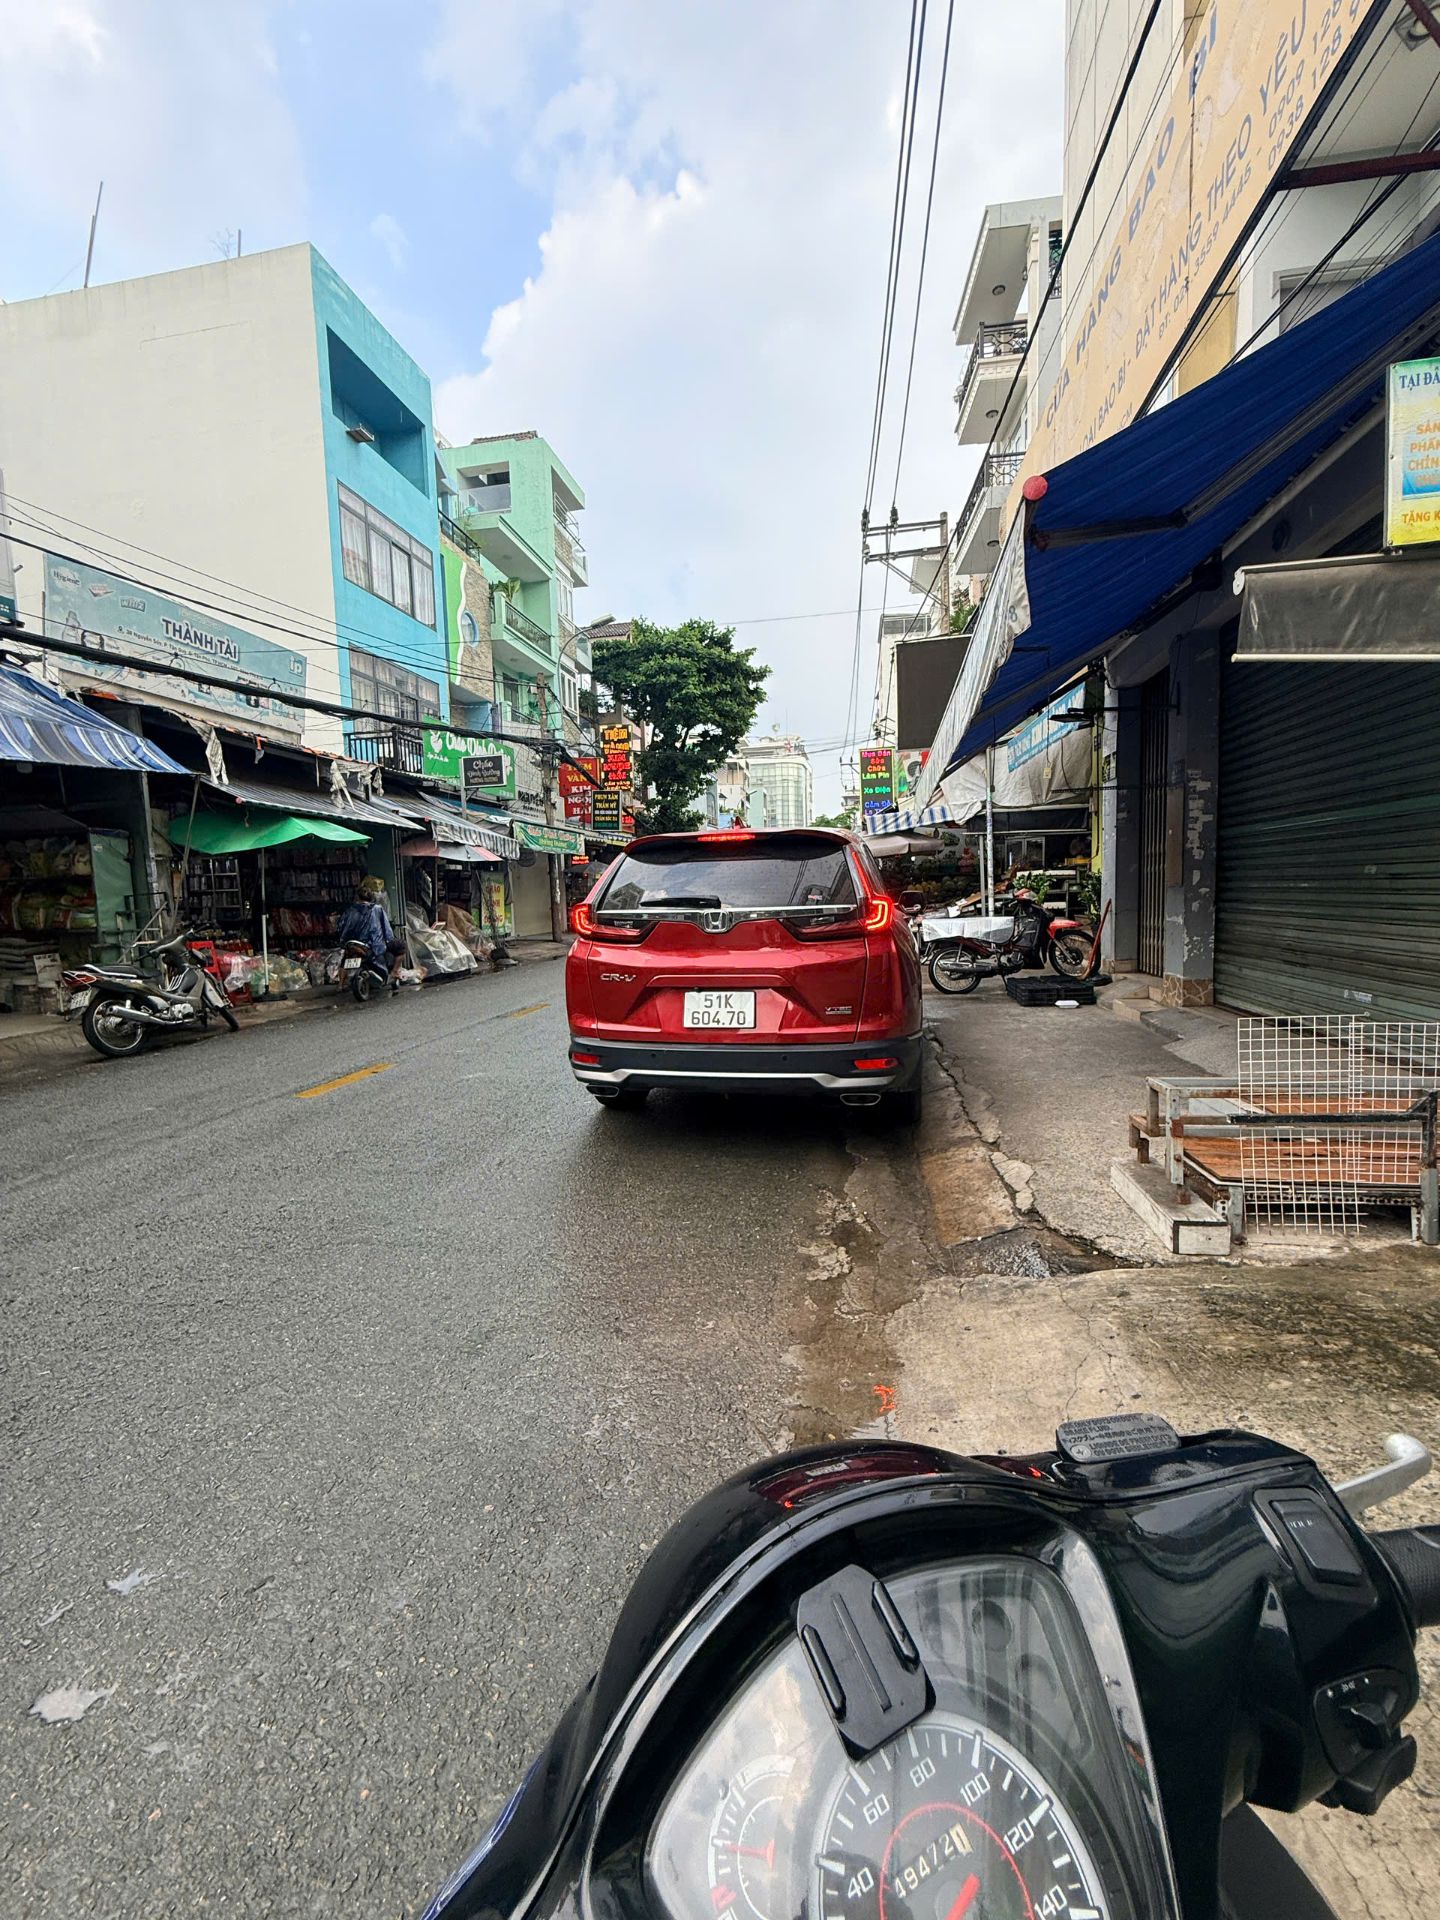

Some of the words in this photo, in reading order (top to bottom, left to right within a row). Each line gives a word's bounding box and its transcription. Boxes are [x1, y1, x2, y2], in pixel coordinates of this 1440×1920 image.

[1268, 58, 1305, 138] 0909
[1268, 94, 1304, 171] 0938
[1311, 25, 1342, 90] 128
[1076, 245, 1122, 366] HÀNG
[1128, 116, 1175, 246] BAO
[1098, 381, 1116, 431] BAO
[1158, 211, 1203, 313] HÀNG
[1206, 113, 1252, 222] THEO
[1399, 372, 1420, 391] TẠI
[1402, 509, 1431, 527] TẶNG
[161, 617, 214, 651] THÀNH
[217, 637, 238, 660] TÀI
[600, 973, 637, 982] CR-V
[691, 1010, 746, 1026] 604.70
[704, 993, 733, 1009] 51K
[909, 1756, 936, 1788] 80
[959, 1772, 991, 1807] 100
[862, 1793, 890, 1825] 60
[1003, 1817, 1035, 1856] 120
[847, 1866, 875, 1899] 40
[1033, 1884, 1068, 1920] 140
